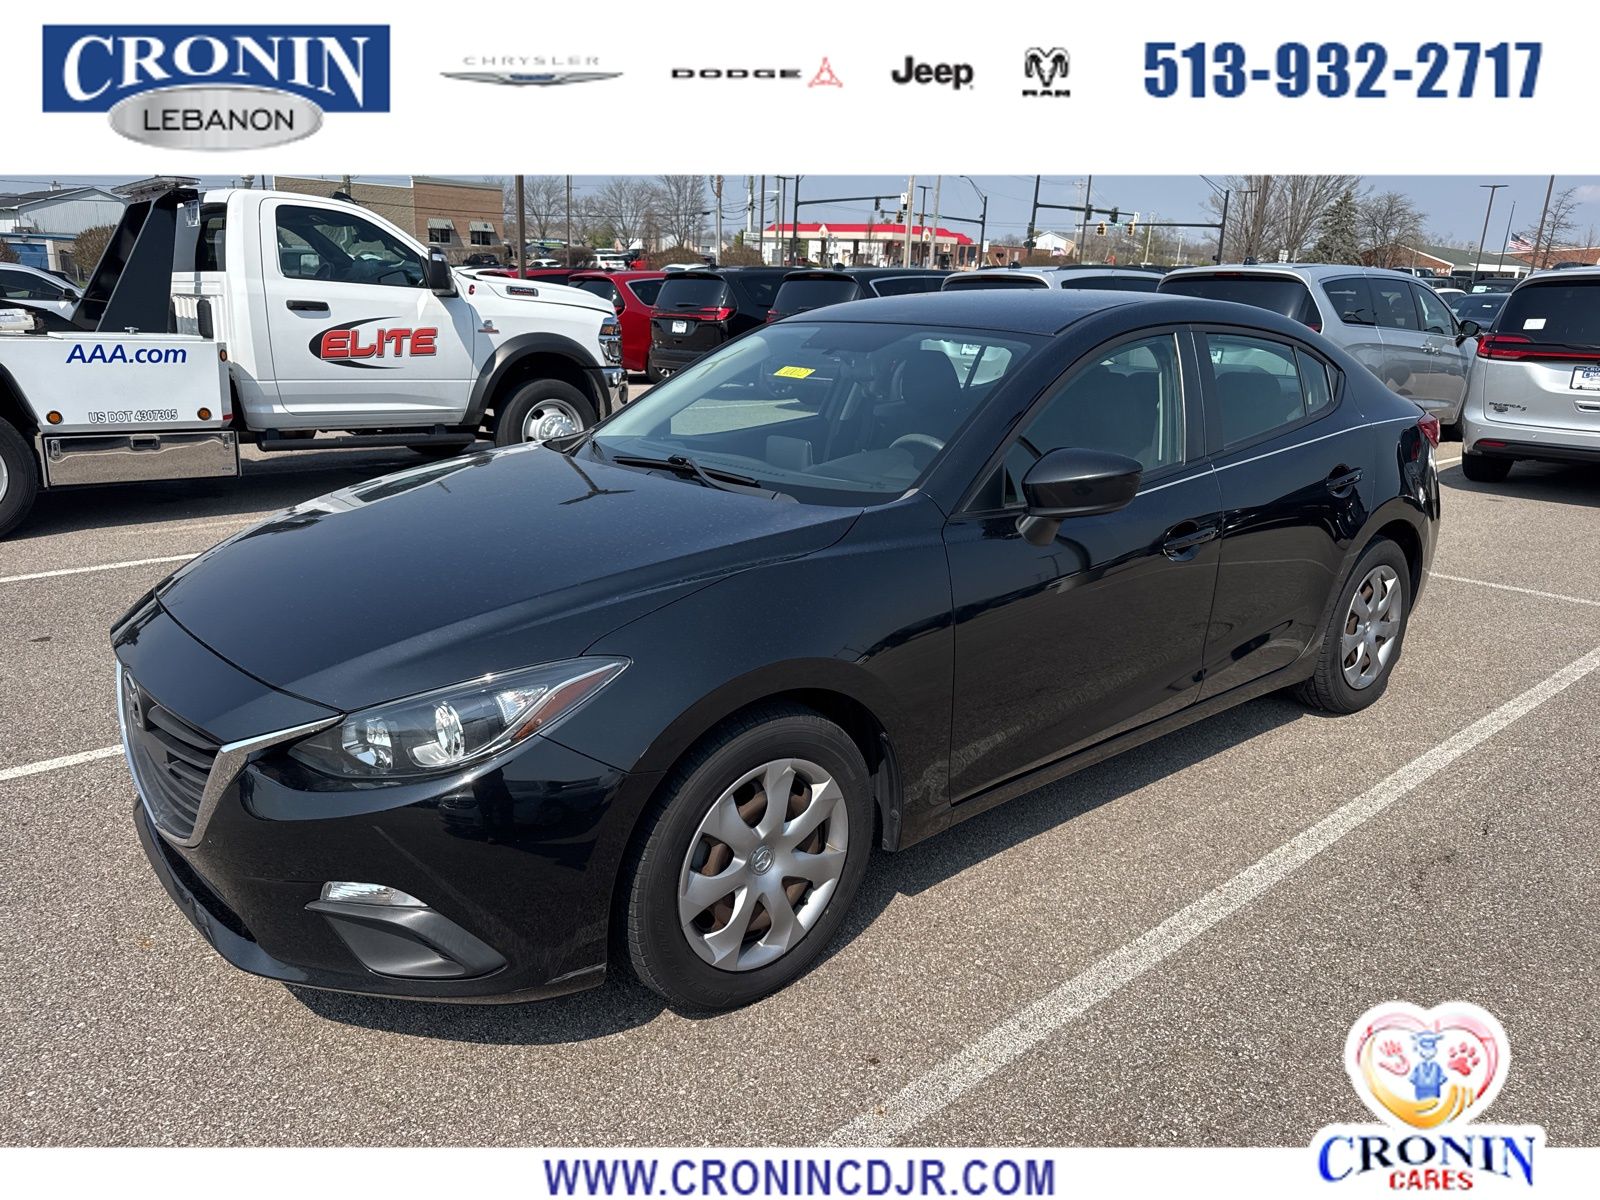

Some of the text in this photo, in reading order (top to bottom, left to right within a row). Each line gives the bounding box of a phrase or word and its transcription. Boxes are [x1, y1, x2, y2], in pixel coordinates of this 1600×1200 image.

[65, 343, 187, 364] AAA.com
[320, 327, 438, 361] ELITE
[88, 408, 178, 423] US DOT 4307305
